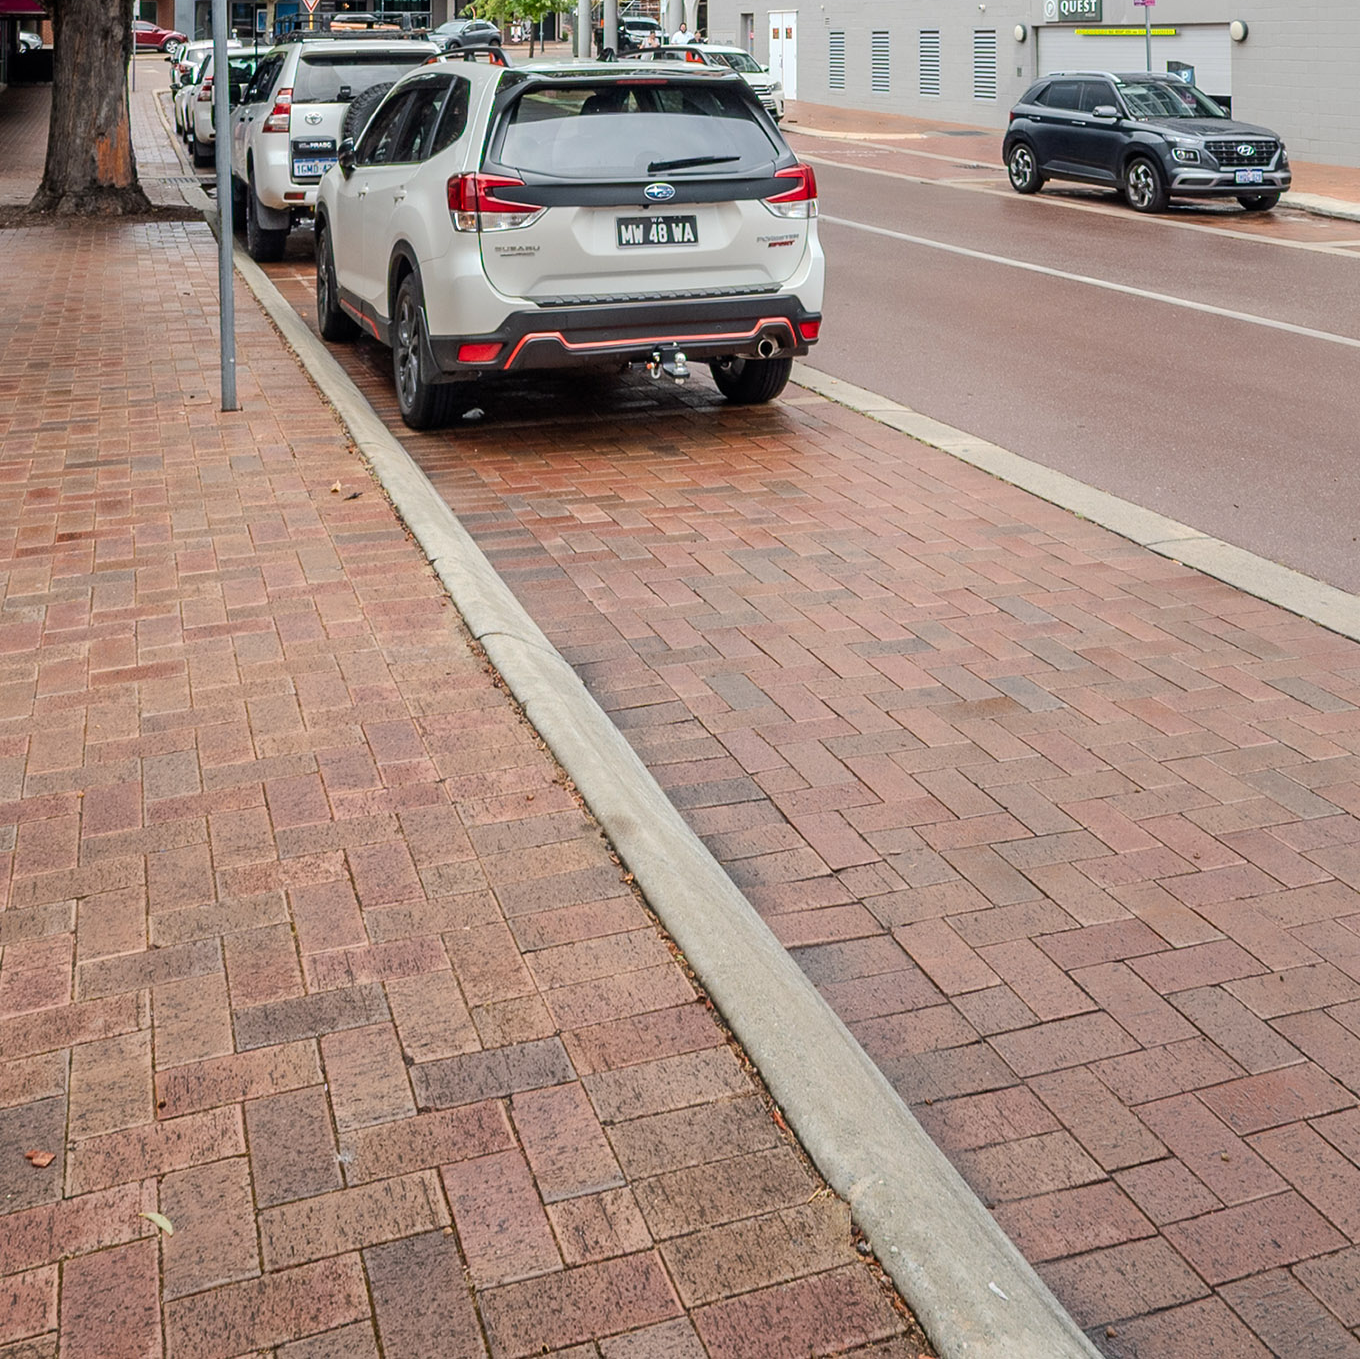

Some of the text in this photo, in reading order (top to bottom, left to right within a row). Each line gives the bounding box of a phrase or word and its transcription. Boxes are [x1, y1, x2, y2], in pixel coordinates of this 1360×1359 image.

[1060, 0, 1097, 15] QUEST
[621, 222, 695, 244] MW 48 WA
